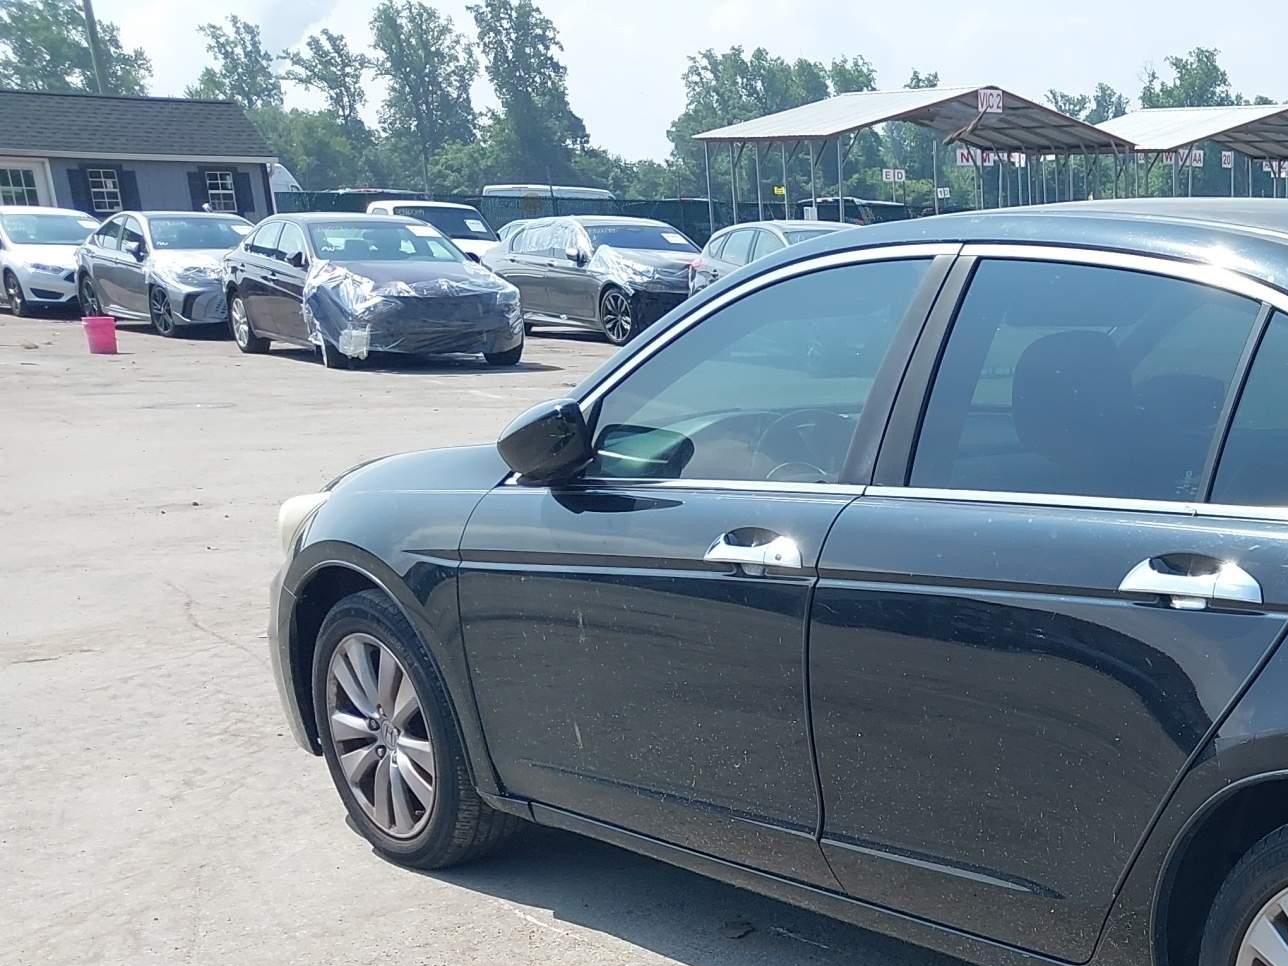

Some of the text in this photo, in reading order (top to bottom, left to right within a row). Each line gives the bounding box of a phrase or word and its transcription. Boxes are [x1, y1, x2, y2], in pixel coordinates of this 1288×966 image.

[979, 92, 1002, 109] VIC 2
[960, 152, 970, 163] N
[1192, 153, 1202, 164] AA
[1223, 154, 1231, 165] 20
[885, 170, 903, 179] E D
